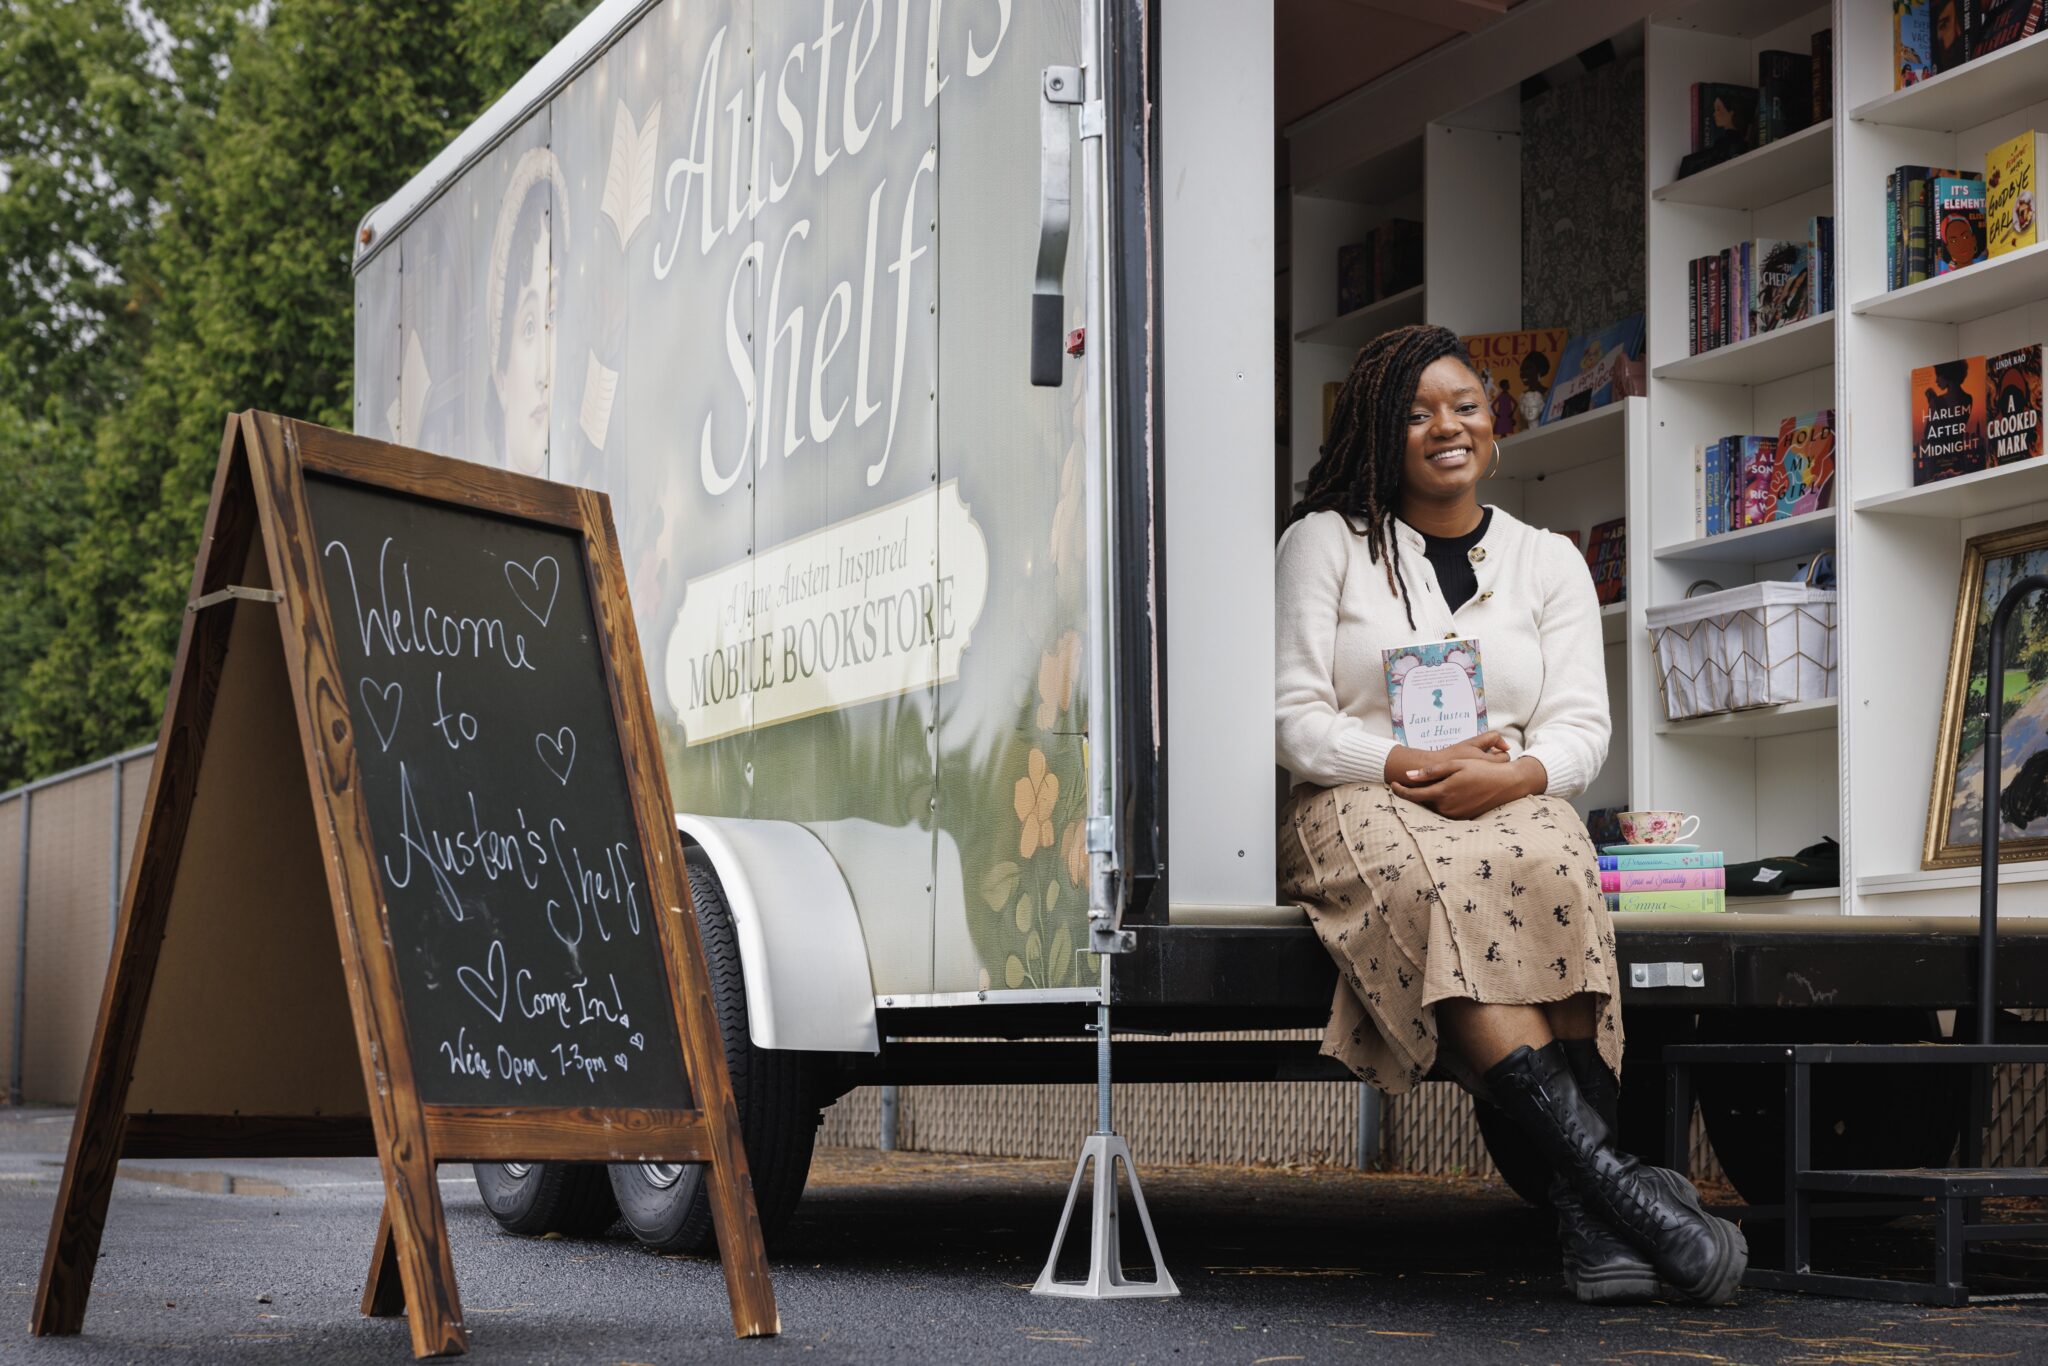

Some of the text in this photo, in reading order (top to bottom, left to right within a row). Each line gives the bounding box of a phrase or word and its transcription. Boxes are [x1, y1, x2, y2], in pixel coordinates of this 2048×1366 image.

[653, 0, 1011, 280] Austens
[1944, 197, 1986, 210] ELEMENT
[1951, 185, 1969, 196] IT'S
[1988, 165, 2031, 218] GOODBYE
[1989, 213, 2013, 244] EARL
[700, 151, 936, 495] Shelf
[1467, 331, 1565, 359] CICELY
[1995, 357, 2012, 370] LINDA
[1922, 404, 1971, 423] HARLEM
[2007, 394, 2016, 413] A
[1783, 426, 1832, 447] HOLD
[1927, 422, 1967, 439] AFTER
[1987, 410, 2038, 439] CROOKED
[1919, 438, 1979, 458] MIDNIGHT
[1997, 433, 2028, 457] MARK
[1790, 456, 1812, 472] MY
[1777, 482, 1817, 500] GIRL
[739, 581, 771, 633] Jane
[776, 563, 830, 608] Austen
[838, 516, 908, 598] Inspired
[325, 537, 536, 671] Welcome
[689, 575, 956, 710] MOBILE BOOKSTORE
[432, 671, 478, 750] to
[1409, 711, 1470, 725] Jane Austen
[1420, 725, 1462, 739] at Home
[384, 761, 640, 946] Austen's Shelf
[516, 968, 571, 1029] Come
[497, 1044, 548, 1085] Open
